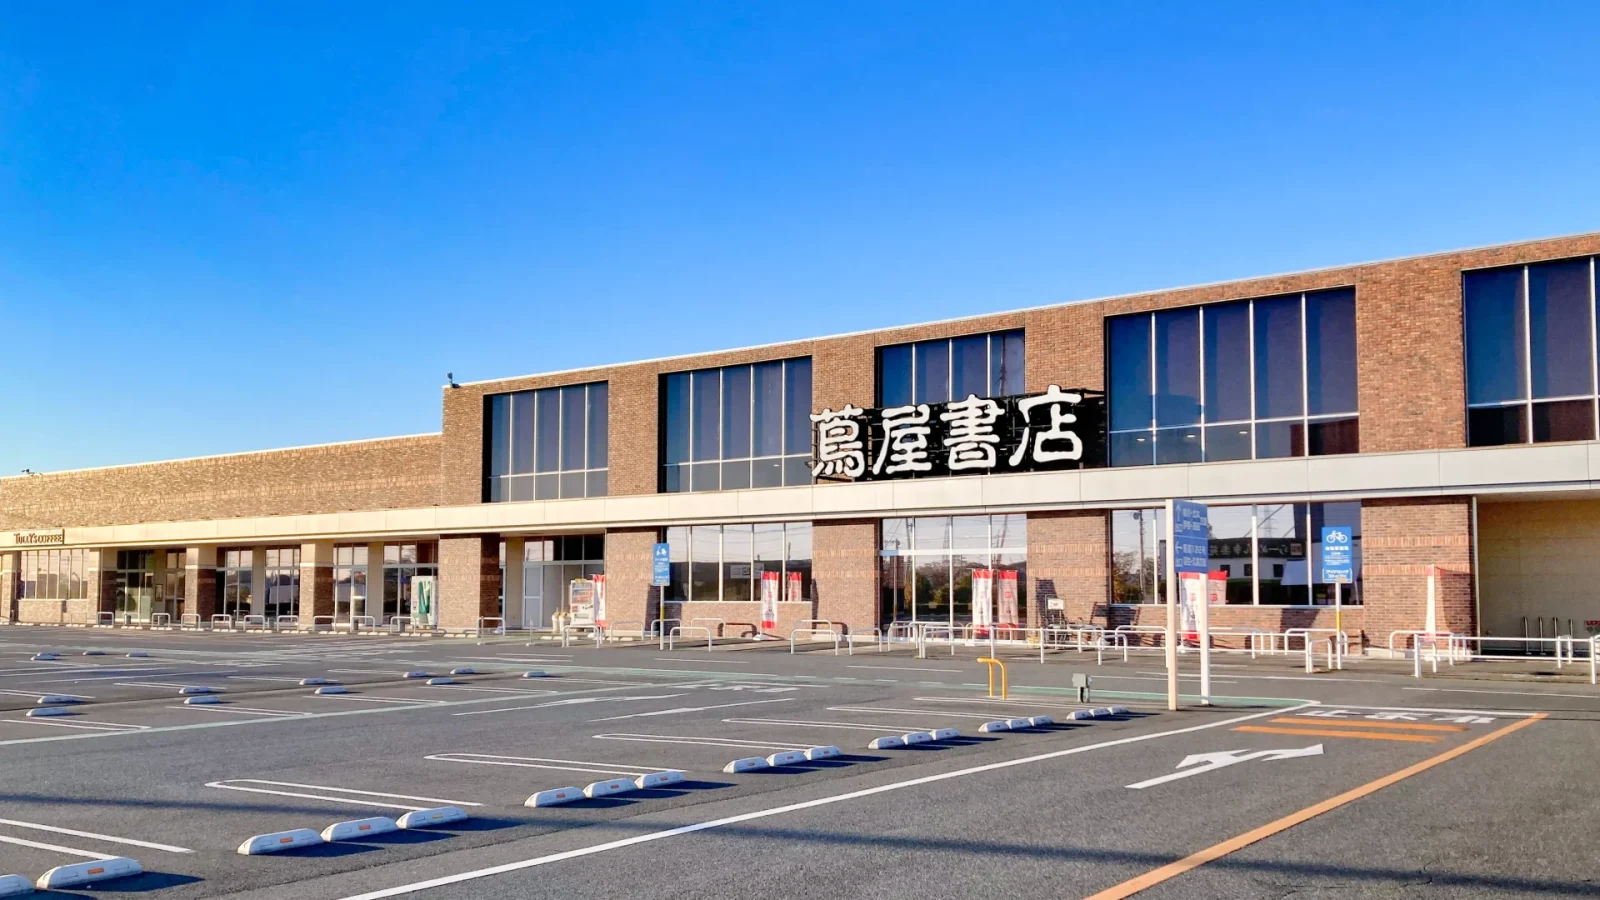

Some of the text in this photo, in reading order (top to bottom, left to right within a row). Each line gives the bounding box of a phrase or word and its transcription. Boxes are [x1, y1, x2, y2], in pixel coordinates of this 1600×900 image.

[809, 384, 1083, 478] 蔦屋書店
[38, 534, 62, 543] COFFEE
